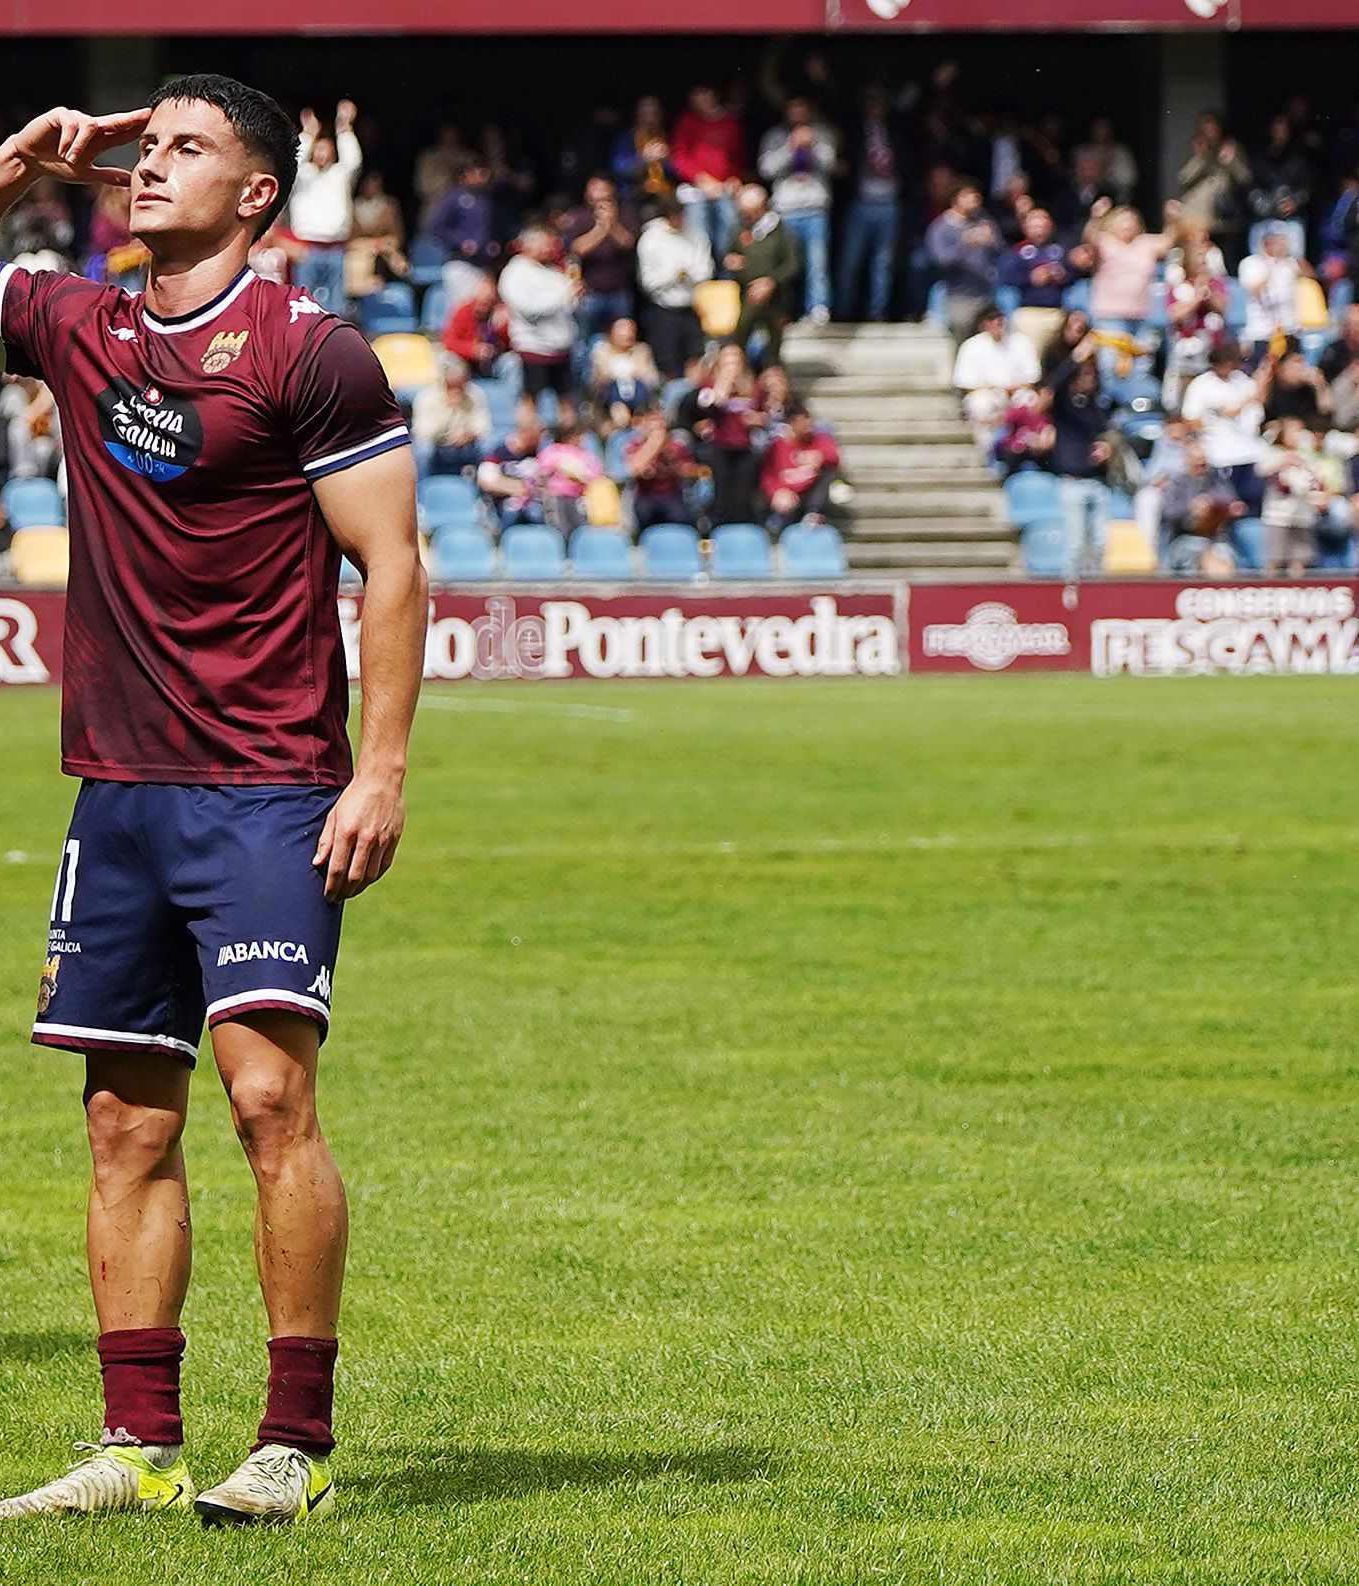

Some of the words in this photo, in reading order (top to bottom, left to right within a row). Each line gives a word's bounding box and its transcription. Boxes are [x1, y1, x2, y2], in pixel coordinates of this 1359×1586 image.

[112, 395, 184, 434] Etrella
[540, 597, 901, 679] Pontevedra
[217, 940, 310, 967] ABANCA
